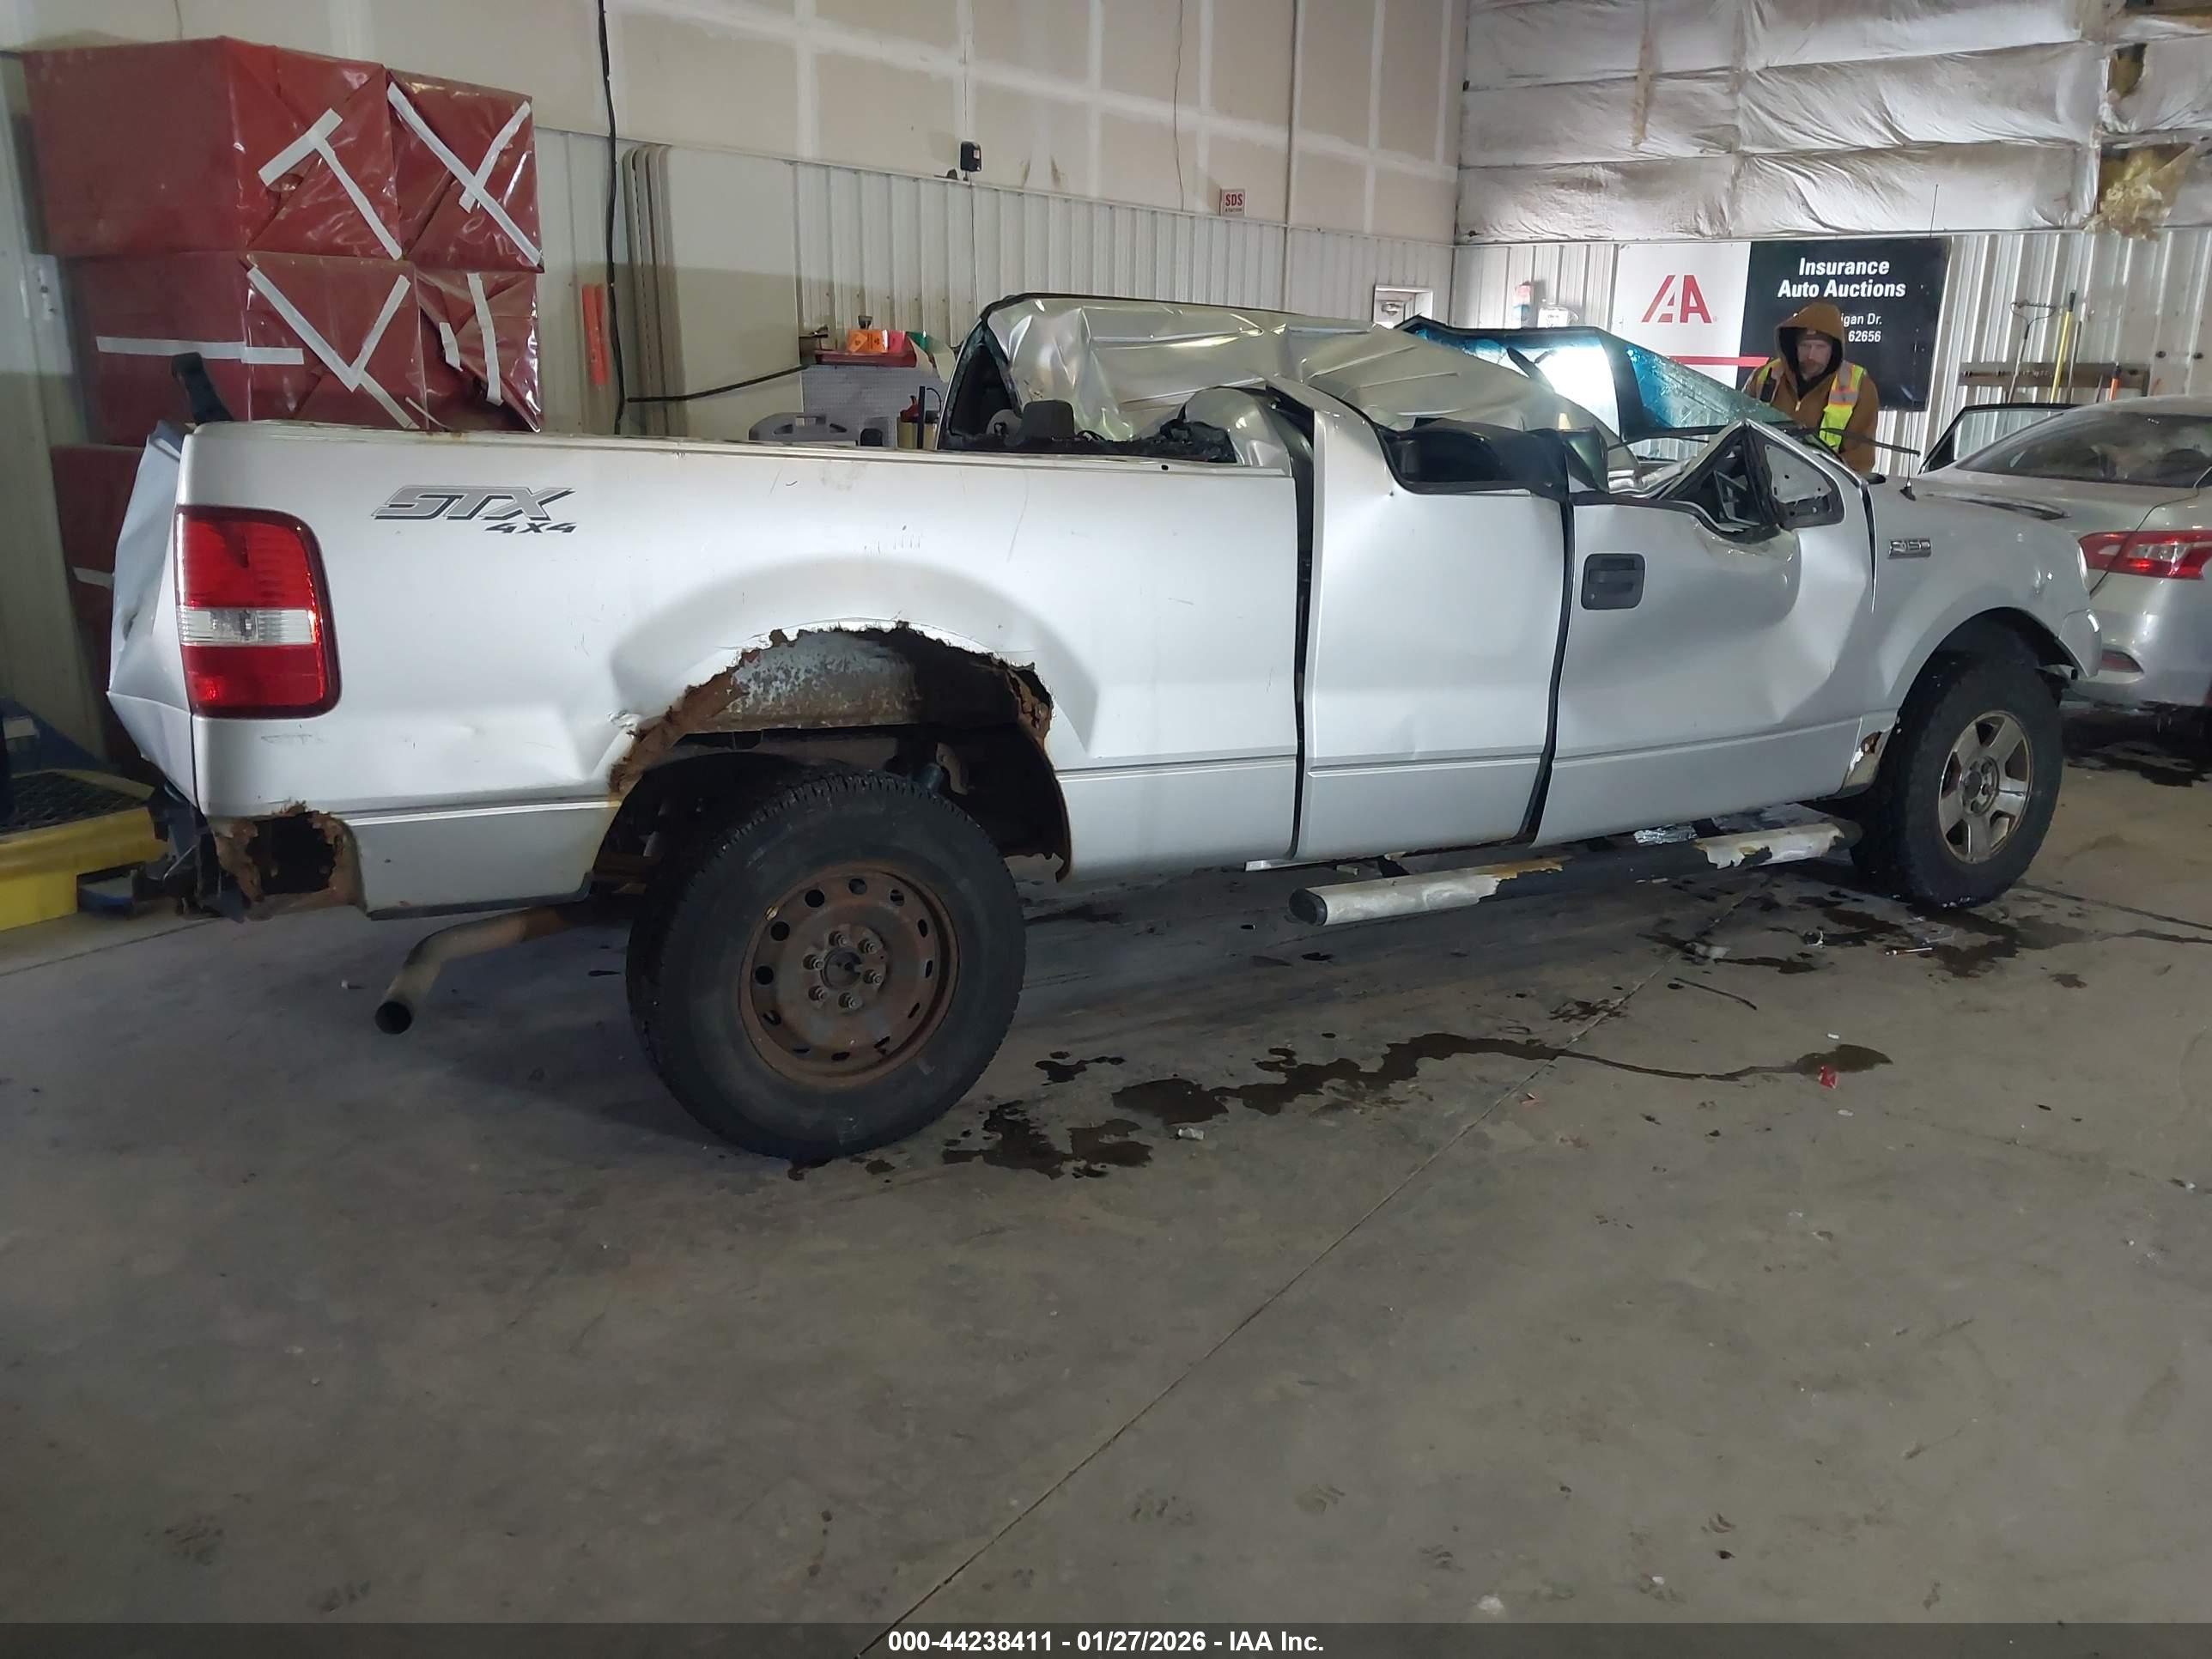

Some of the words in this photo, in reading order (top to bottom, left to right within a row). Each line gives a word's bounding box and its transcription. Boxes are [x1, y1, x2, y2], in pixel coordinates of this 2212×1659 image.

[1225, 192, 1243, 206] SDS
[1799, 257, 1890, 276] Insurance
[1778, 279, 1820, 297] Auto
[1823, 279, 1906, 297] Auctions
[1867, 313, 1882, 325] Dr.
[1848, 330, 1881, 342] 62656
[371, 485, 575, 521] STX
